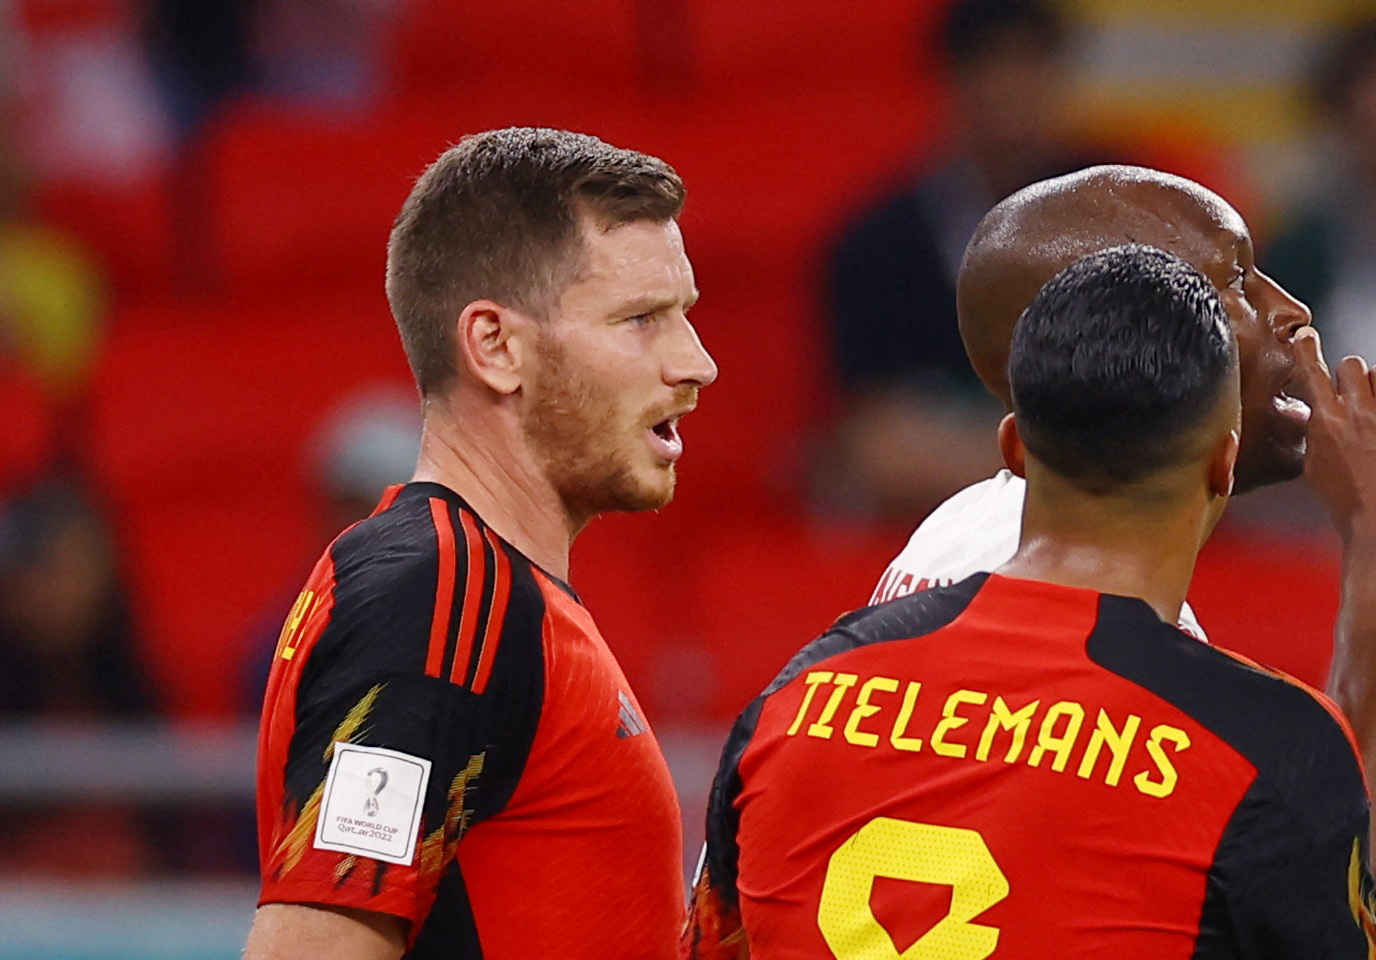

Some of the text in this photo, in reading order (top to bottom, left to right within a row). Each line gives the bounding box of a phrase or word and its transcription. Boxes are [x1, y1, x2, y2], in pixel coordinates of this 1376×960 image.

[787, 671, 1191, 798] TIELEMANS
[336, 816, 398, 834] FIFA WORLD CUP
